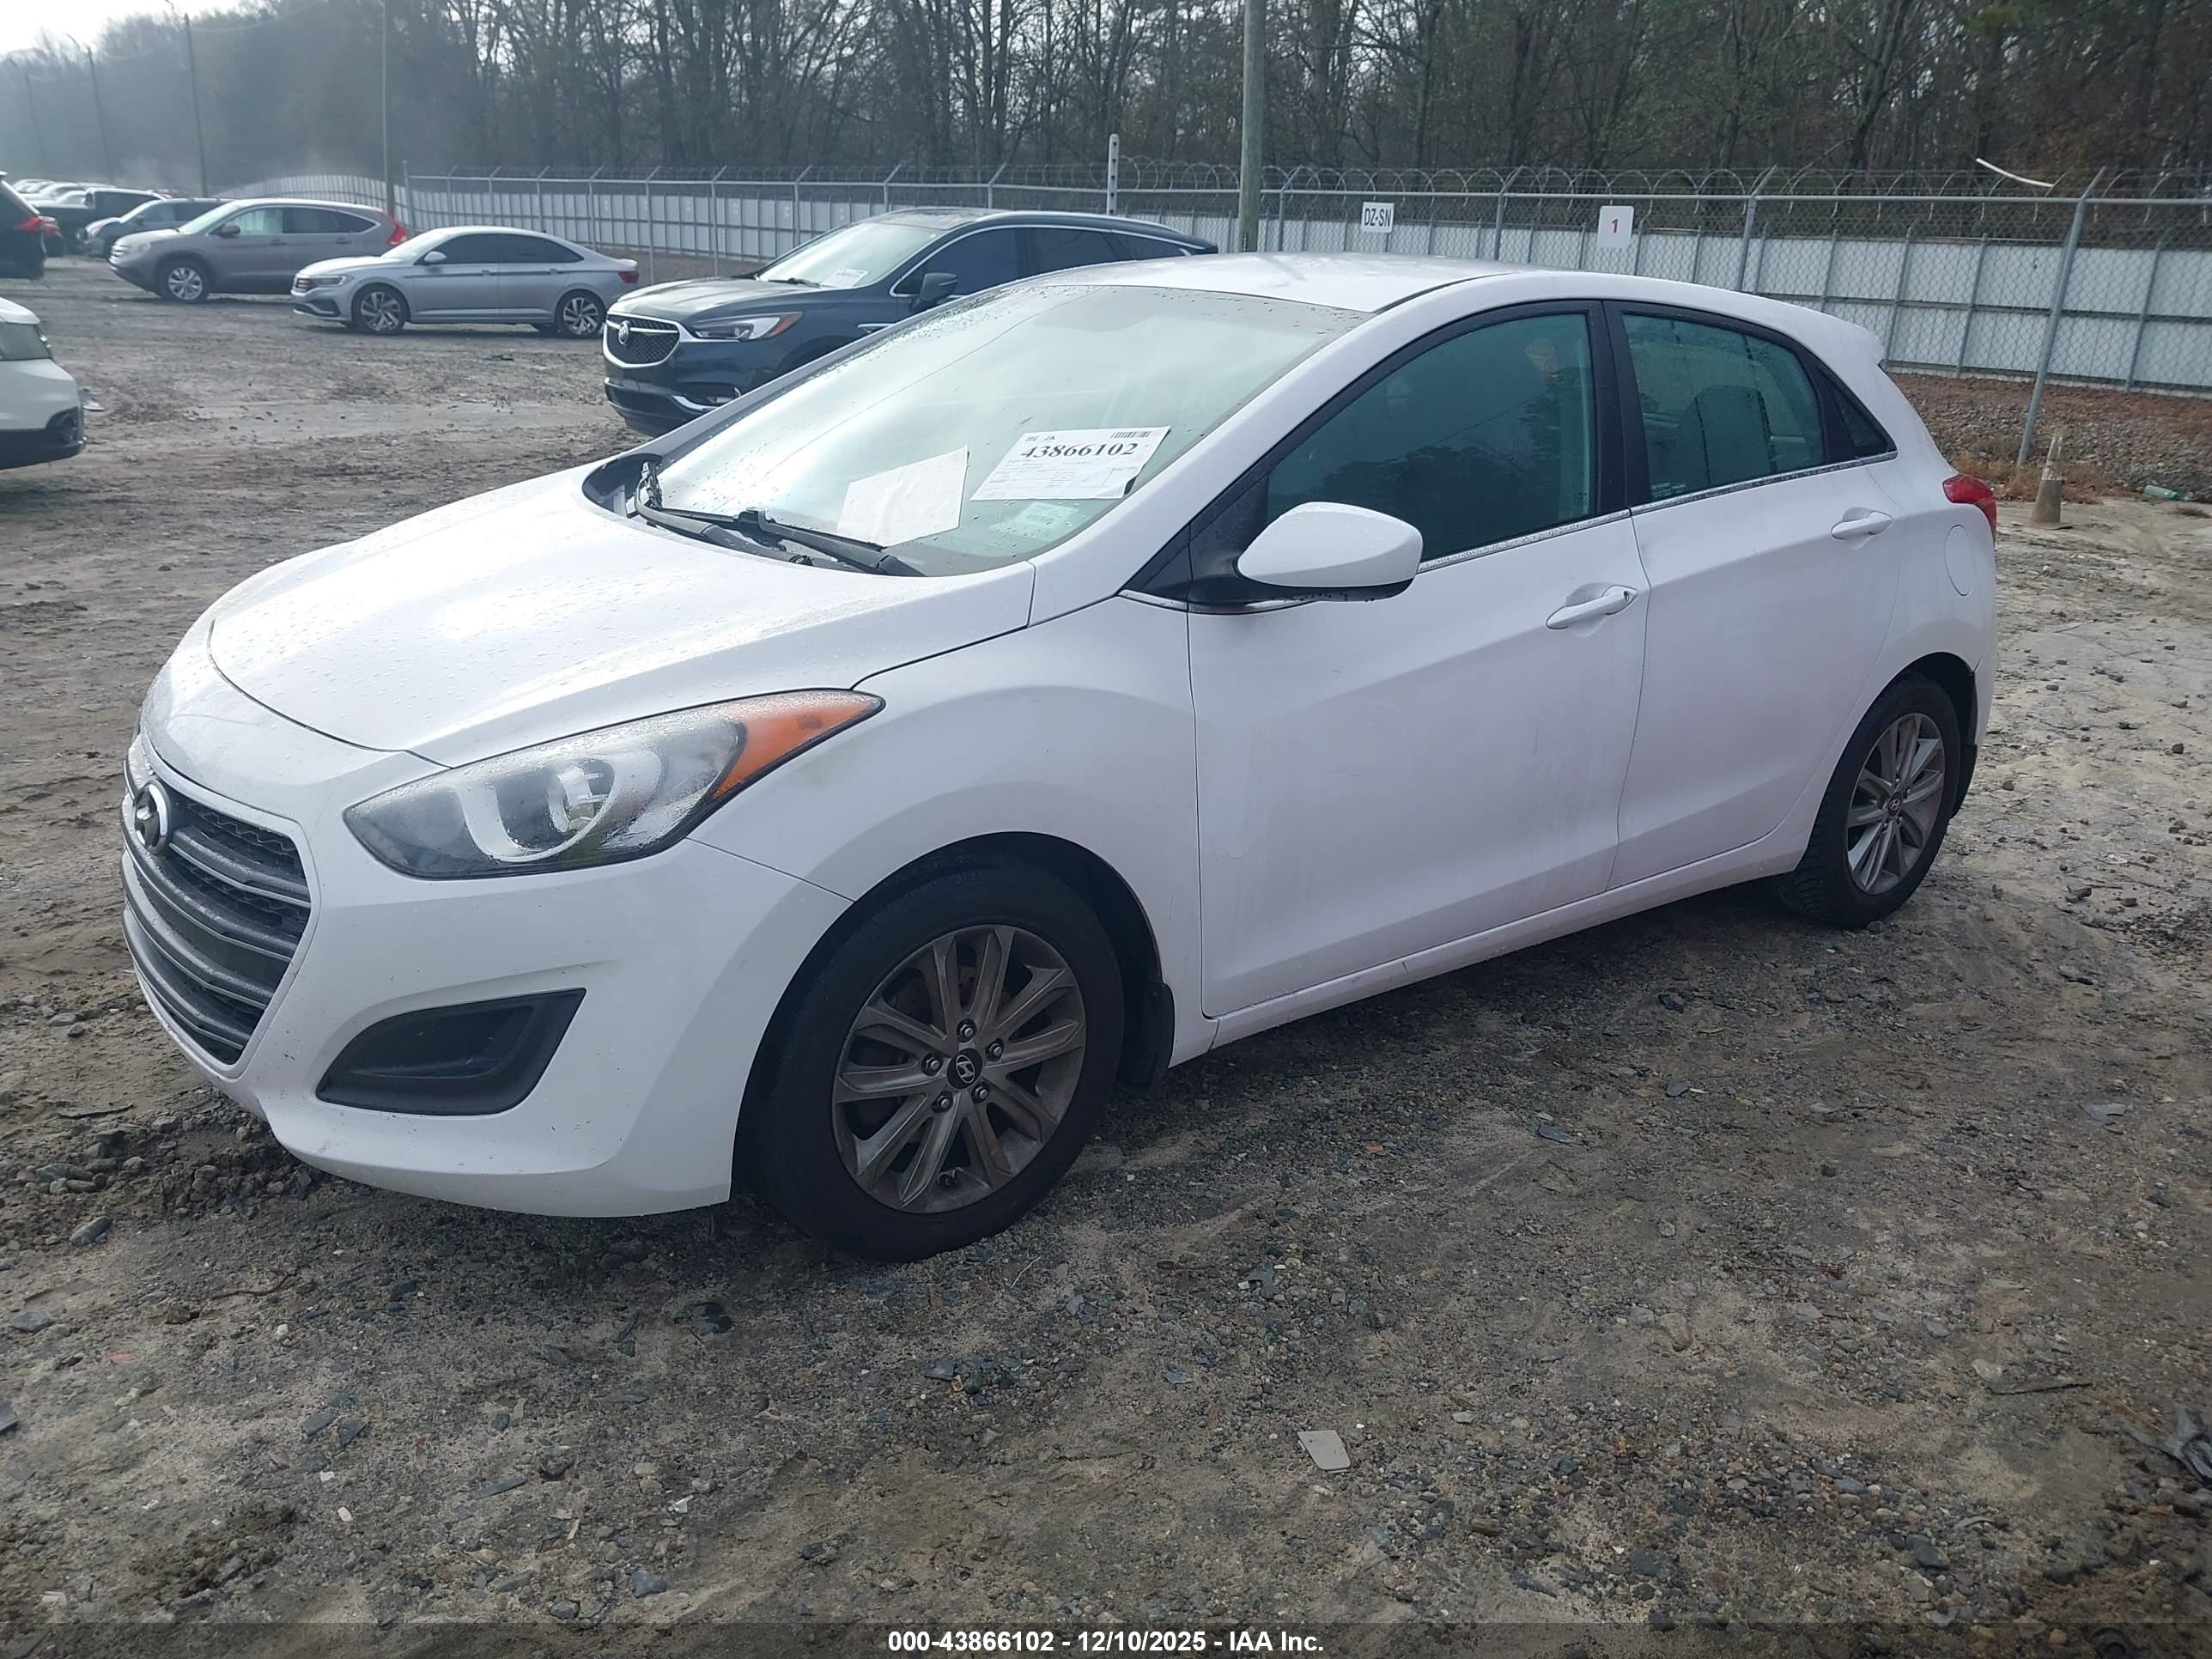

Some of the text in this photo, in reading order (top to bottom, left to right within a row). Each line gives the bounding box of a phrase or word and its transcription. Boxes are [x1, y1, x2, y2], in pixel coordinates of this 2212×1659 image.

[1364, 208, 1392, 228] DZ-SN
[1611, 218, 1619, 234] 1
[1021, 442, 1139, 459] 43866102
